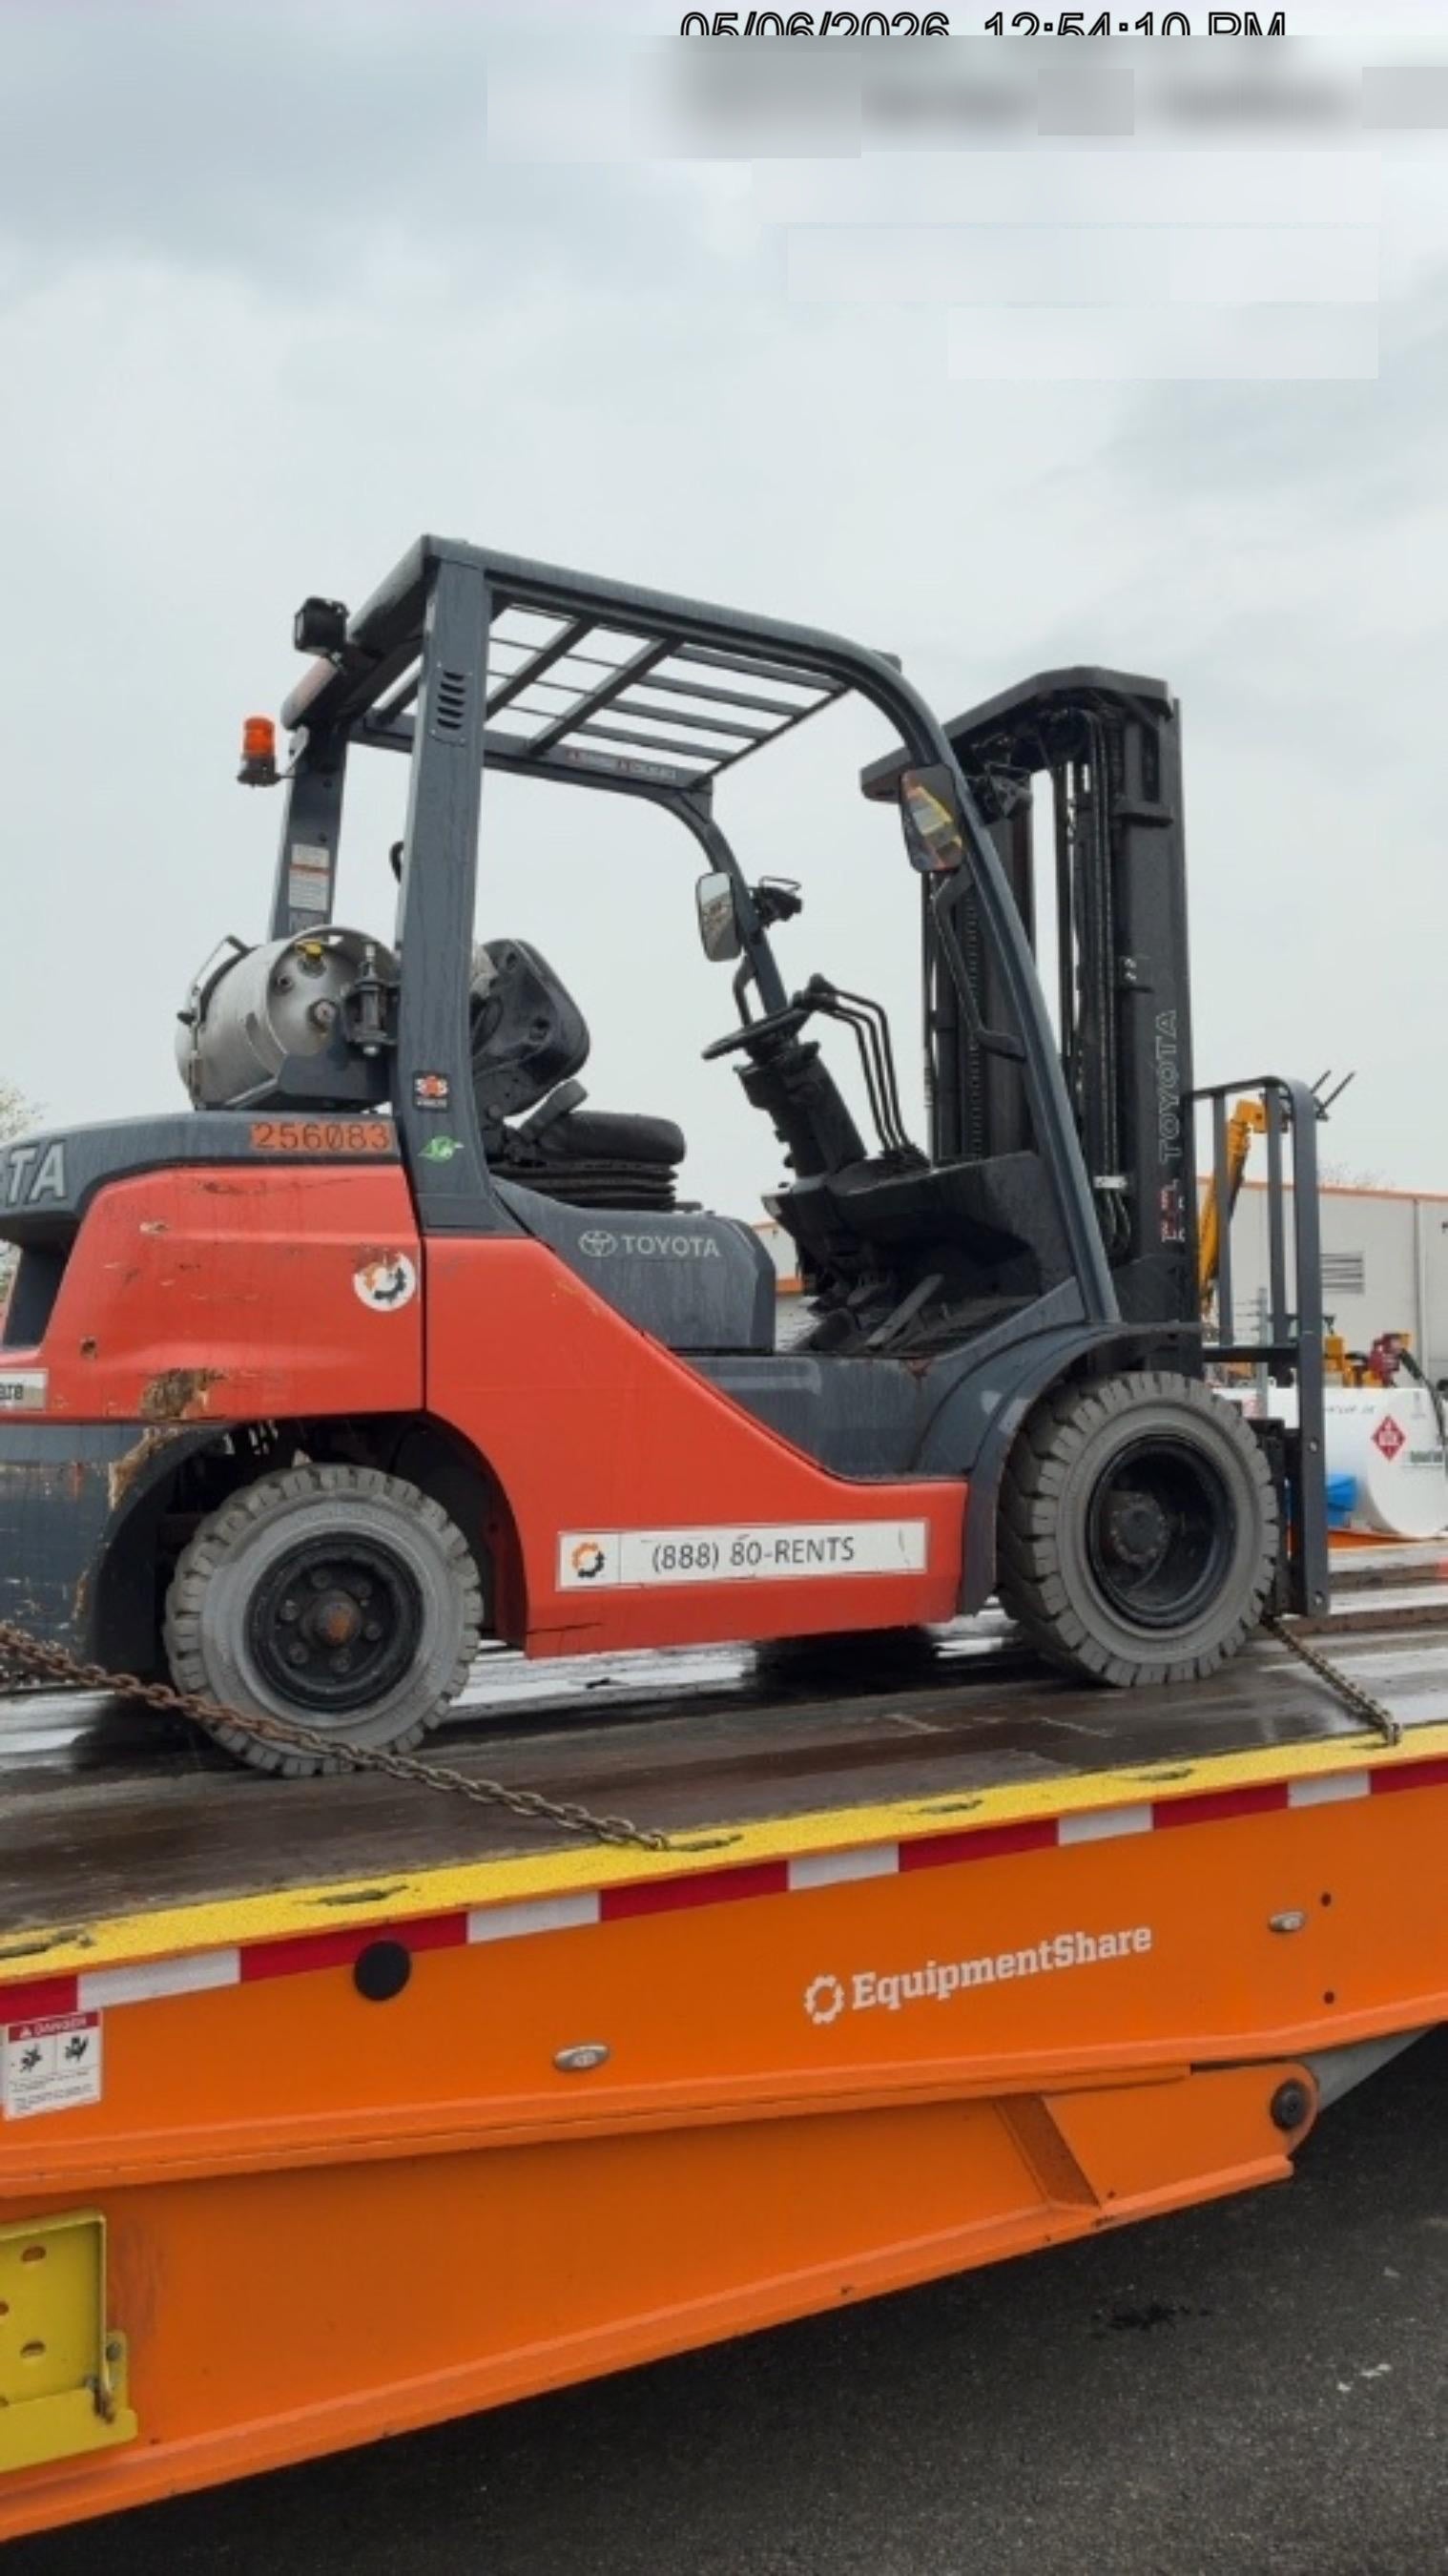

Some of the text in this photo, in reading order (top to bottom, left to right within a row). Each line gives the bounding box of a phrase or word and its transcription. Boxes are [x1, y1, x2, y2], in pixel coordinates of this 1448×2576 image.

[1155, 1009, 1183, 1166] TOYOTA
[253, 1121, 390, 1150] 256083
[620, 1234, 722, 1257] TOYOTA
[652, 1535, 855, 1572] (888) 80-RENTS
[851, 1924, 1153, 2011] EquipmentShare
